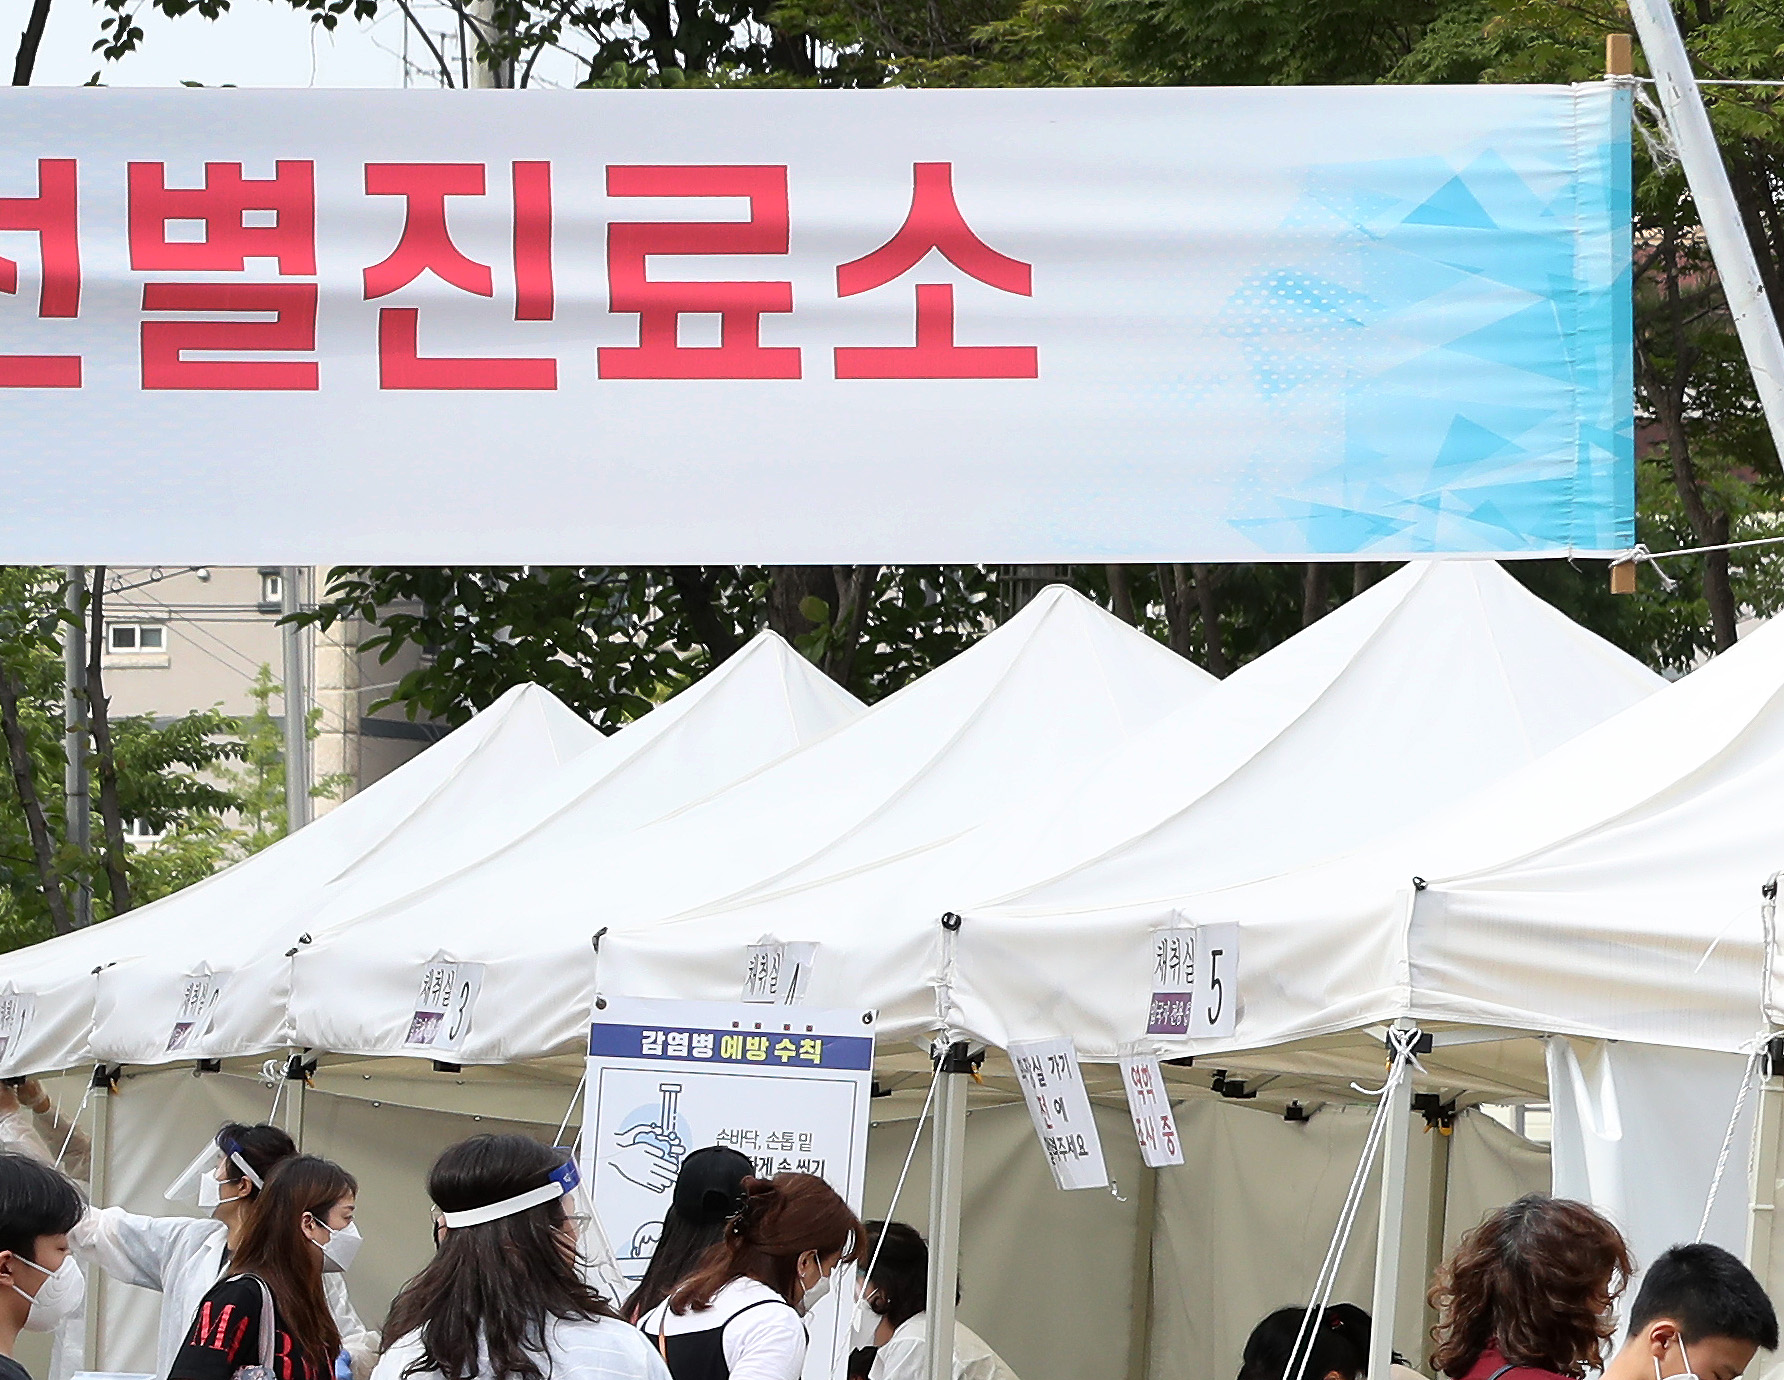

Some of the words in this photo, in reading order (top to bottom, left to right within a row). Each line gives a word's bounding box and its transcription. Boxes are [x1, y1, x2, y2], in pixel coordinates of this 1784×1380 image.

[745, 953, 781, 995] 채취실
[1154, 936, 1195, 985] 채취실
[1207, 949, 1223, 1025] 5
[418, 968, 455, 1006] 채취실
[449, 981, 470, 1040] 3
[640, 1030, 714, 1059] 감염병
[719, 1035, 770, 1062] 예방
[774, 1038, 823, 1064] 수칙
[1047, 1052, 1073, 1081] 가기
[1130, 1063, 1157, 1105] 역학
[766, 1130, 795, 1151] 손톱
[1160, 1115, 1175, 1156] 중
